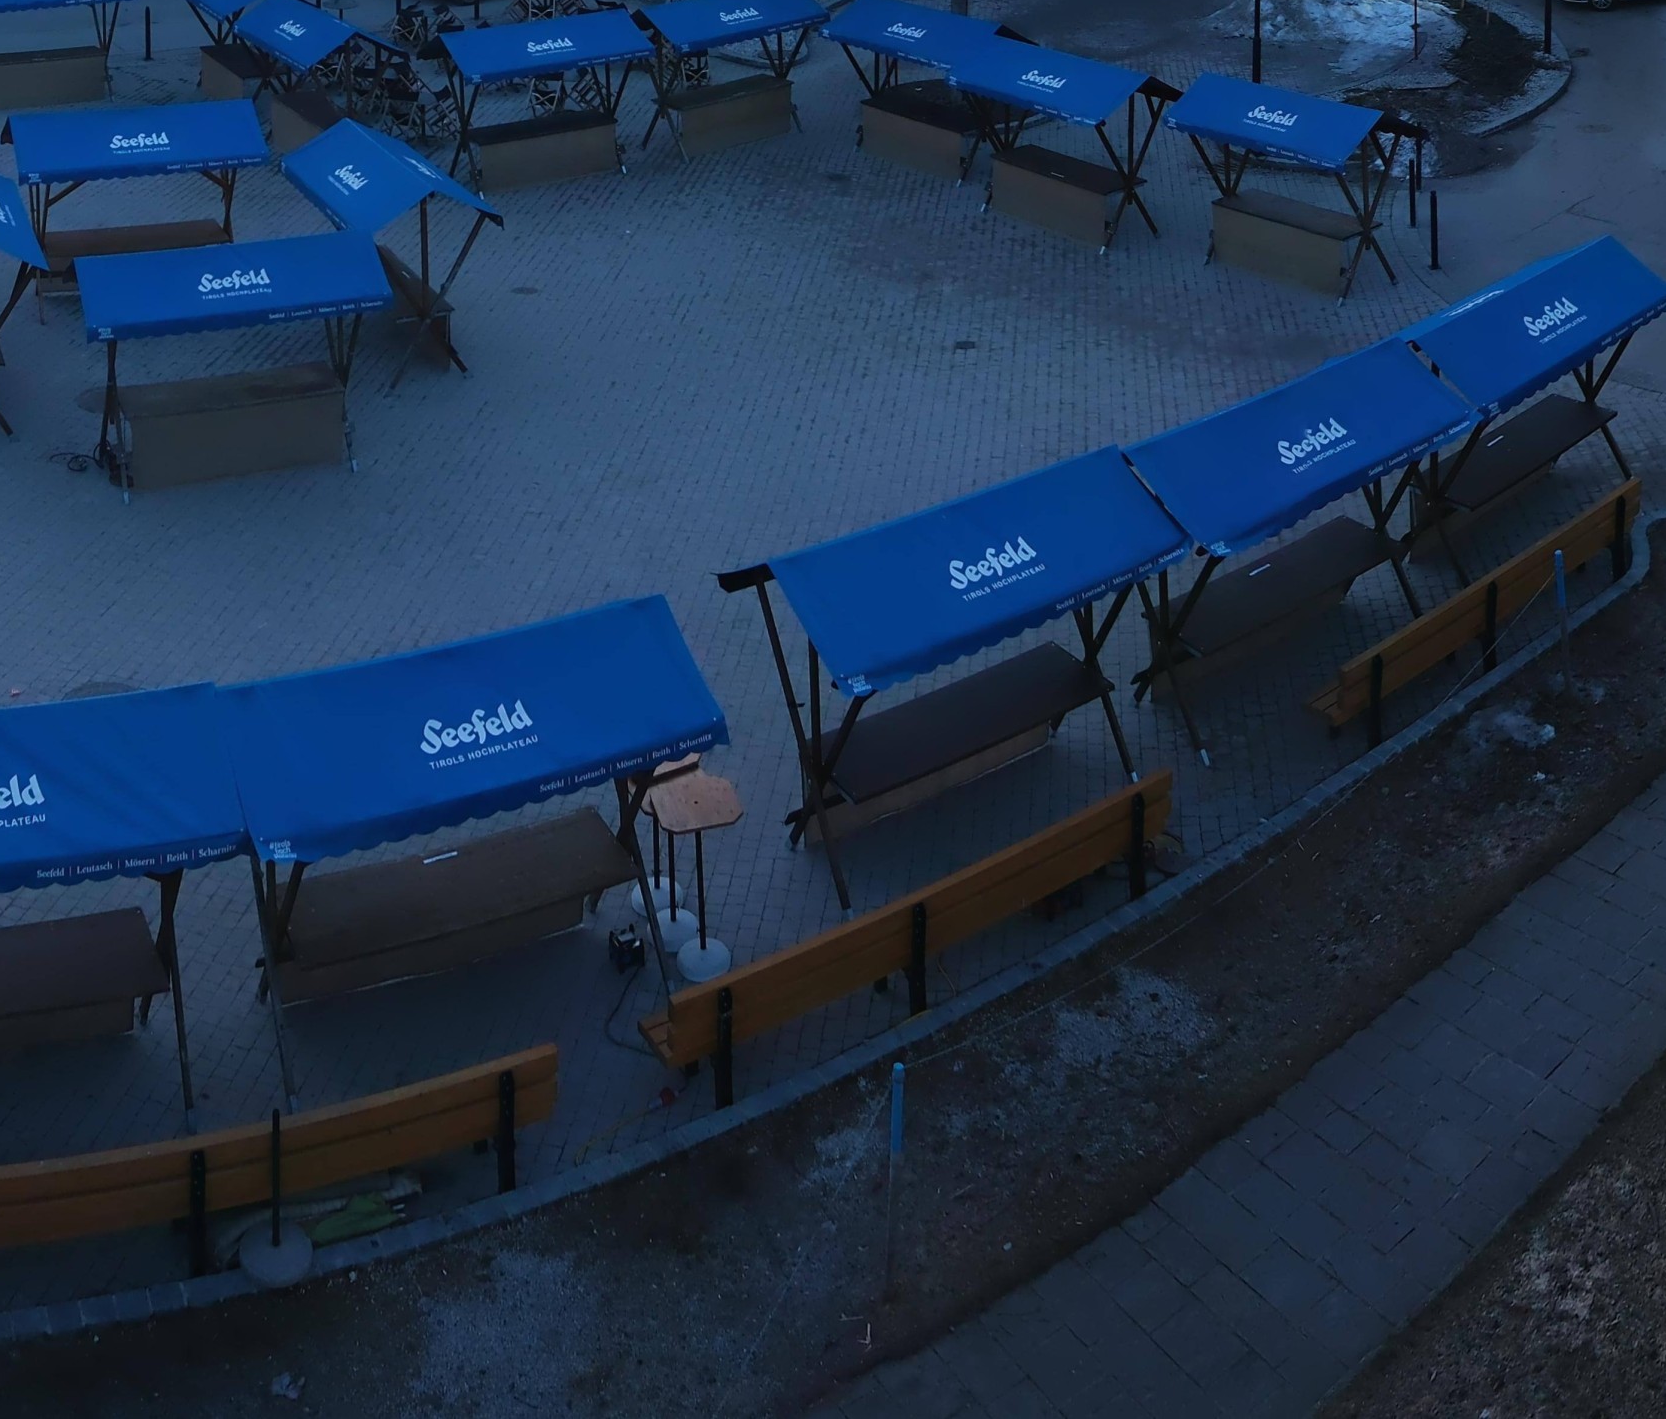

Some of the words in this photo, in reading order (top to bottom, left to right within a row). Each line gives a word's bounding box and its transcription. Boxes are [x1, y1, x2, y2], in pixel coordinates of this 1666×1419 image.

[719, 7, 760, 22] Seefeld
[527, 37, 573, 53] Seefeld
[887, 23, 928, 39] Seefeld
[1021, 70, 1067, 89] Seefeld
[1248, 105, 1299, 126] Seefeld
[109, 131, 170, 149] Seefeld
[334, 165, 369, 190] Seefeld
[198, 268, 271, 293] Seefeld
[1523, 296, 1579, 337] Seefeld
[1278, 417, 1348, 465] Seefeld
[949, 536, 1037, 590] Seefeld
[962, 586, 991, 602] TIROLS
[992, 564, 1046, 590] HOCHPLATEAU
[420, 699, 533, 754] Seefeld
[428, 755, 465, 770] TIROLS
[468, 734, 538, 760] HOCHPLATEAU
[539, 779, 564, 793] Seefeld
[574, 767, 606, 783] Leutasch
[616, 755, 643, 770] Mösern
[652, 747, 670, 760] Reith
[679, 732, 712, 749] Scharnitz
[36, 867, 64, 878] Seefeld
[76, 862, 112, 874] Leutasch
[124, 856, 154, 867] Mösern
[166, 851, 188, 862] Reith
[198, 843, 236, 858] Scharnitz
